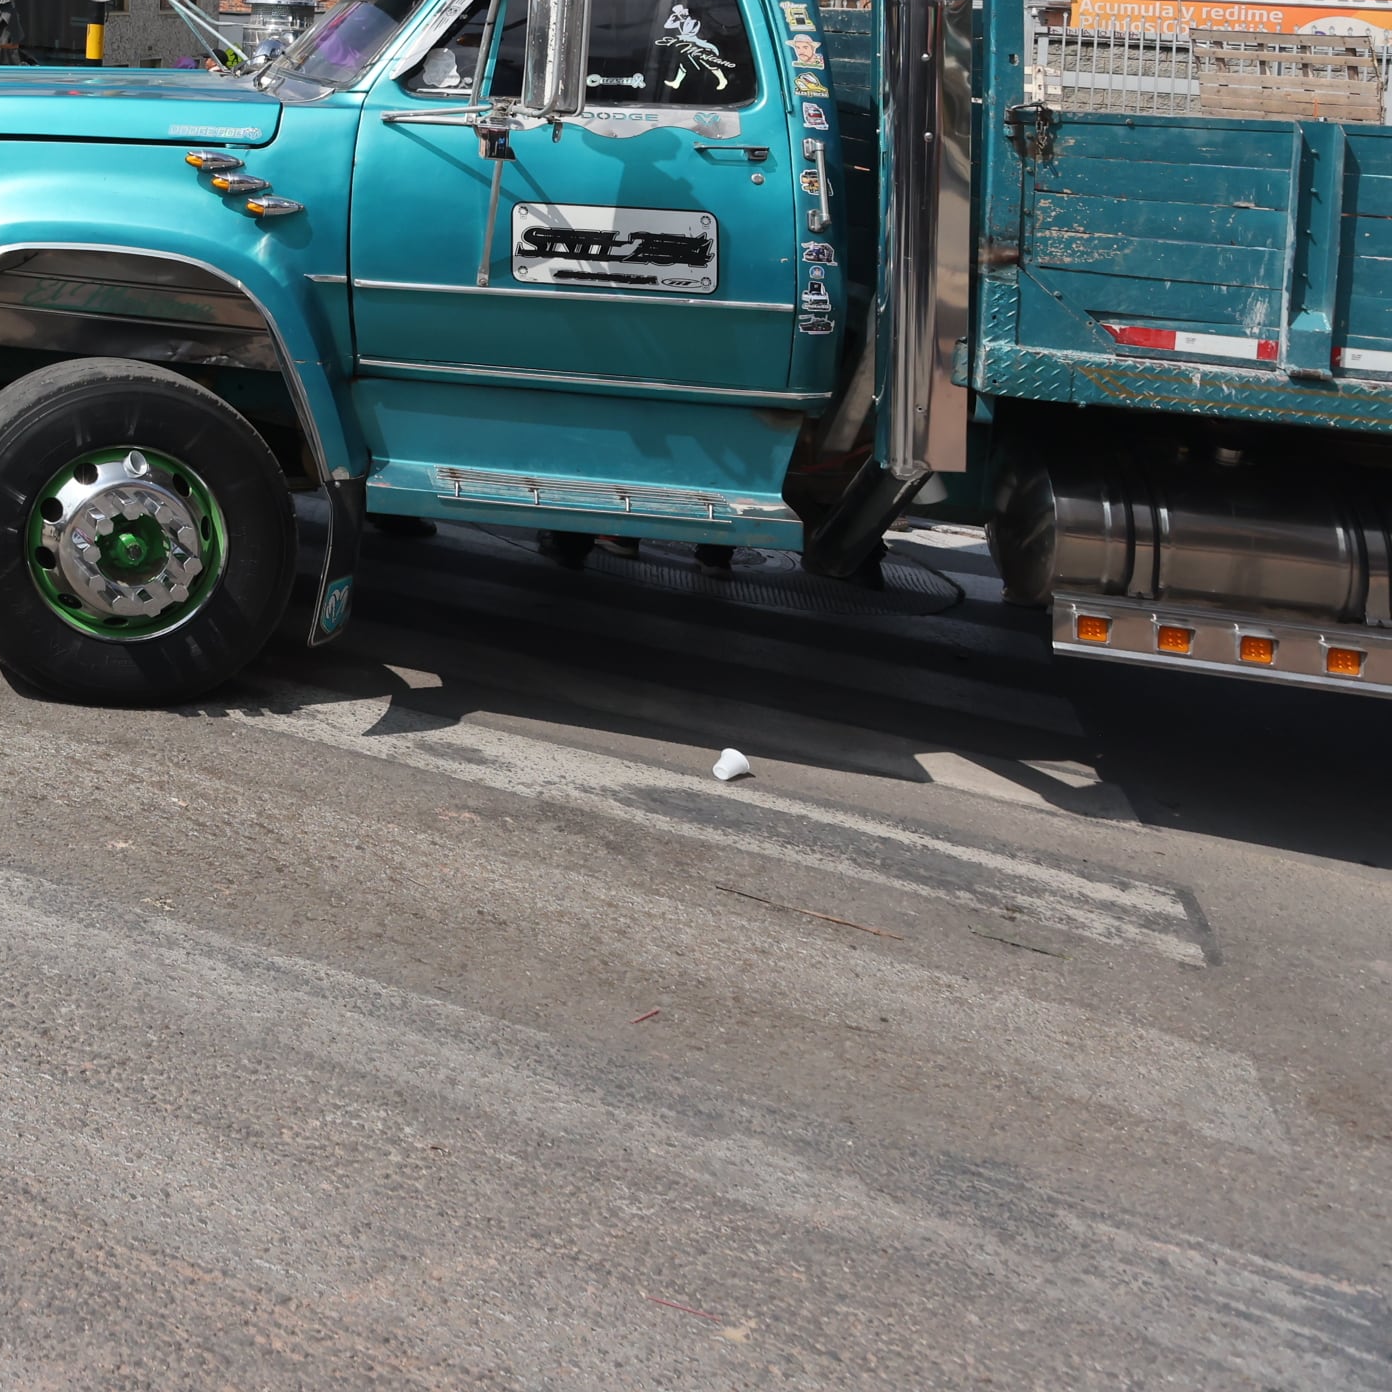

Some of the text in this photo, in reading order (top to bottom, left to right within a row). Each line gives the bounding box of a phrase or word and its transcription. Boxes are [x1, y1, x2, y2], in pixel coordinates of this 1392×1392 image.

[1180, 7, 1195, 21] y
[1201, 6, 1284, 23] redime
[580, 110, 659, 122] DODGE
